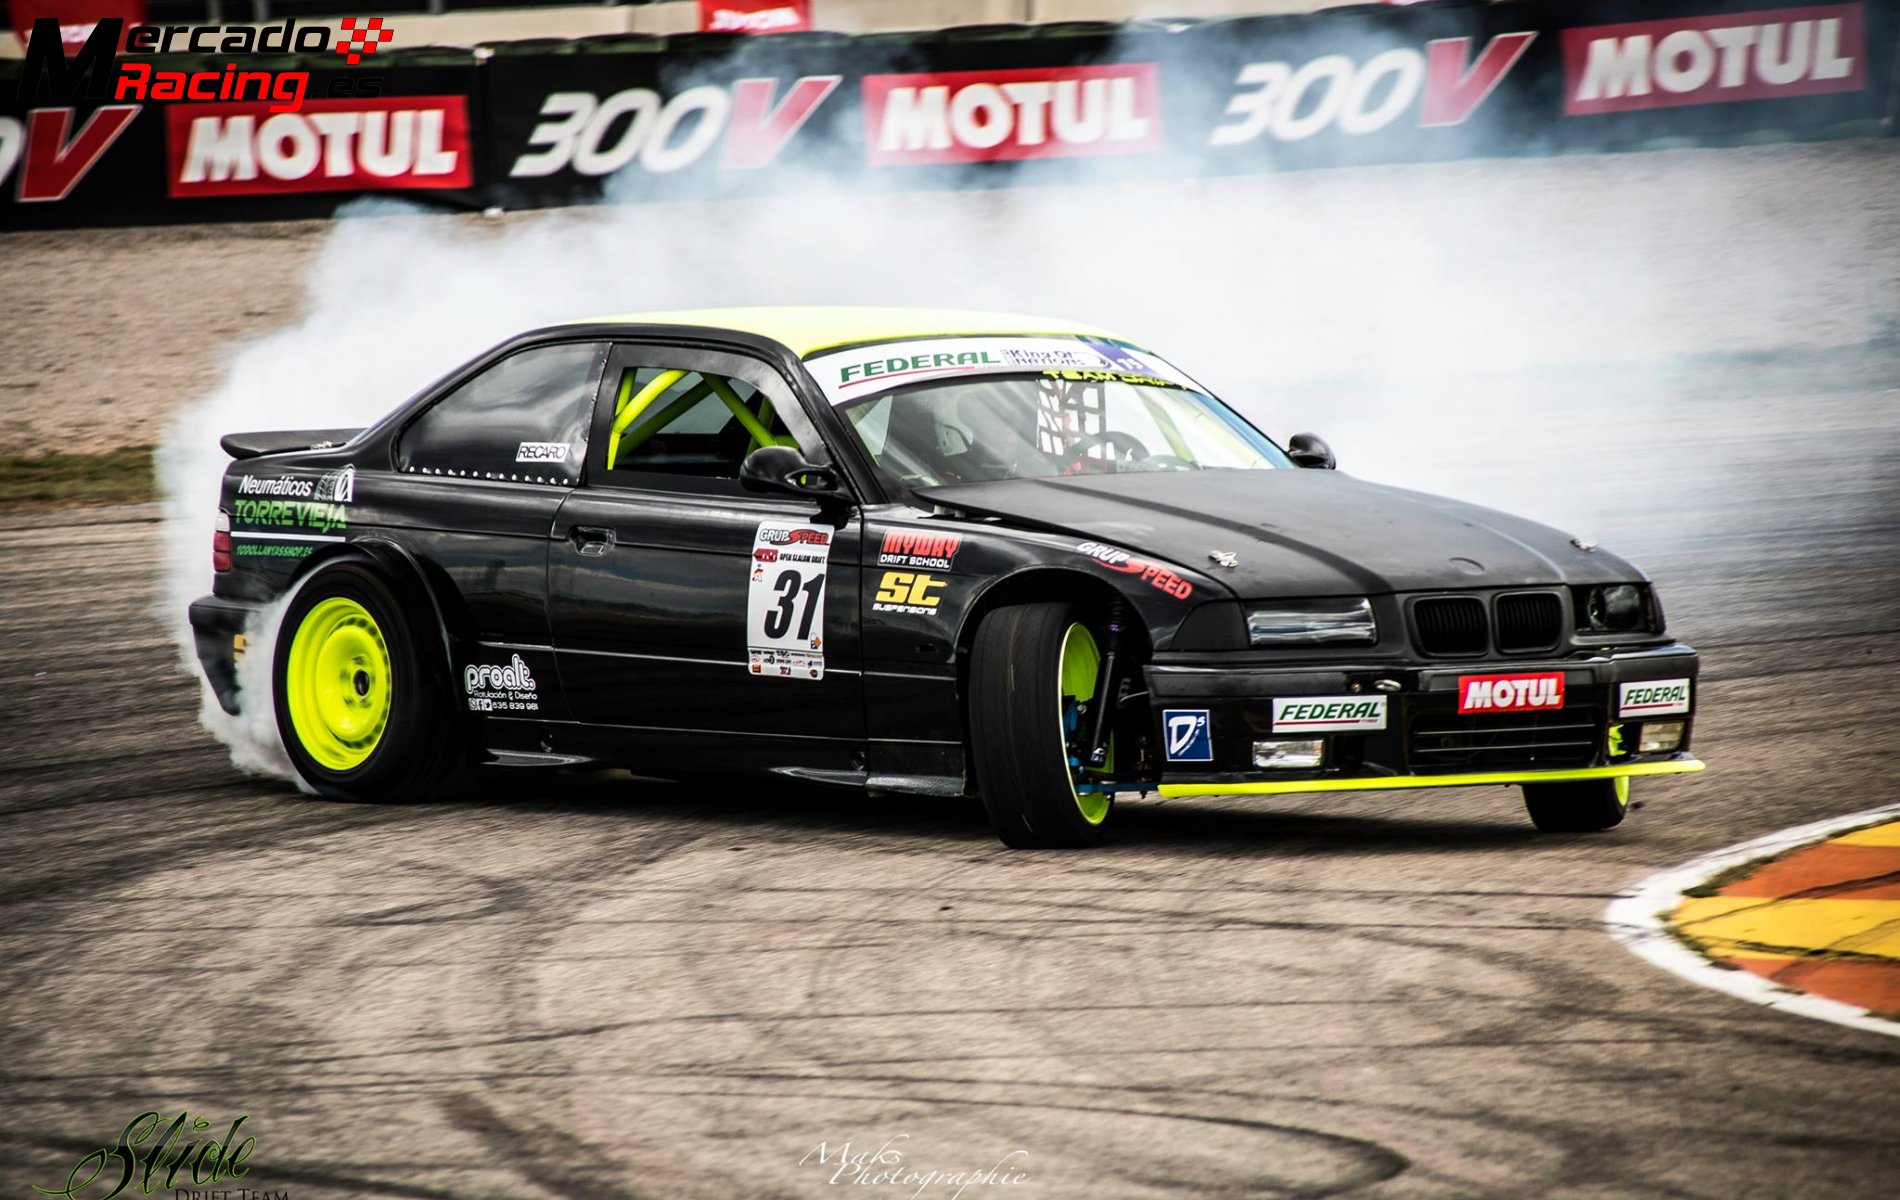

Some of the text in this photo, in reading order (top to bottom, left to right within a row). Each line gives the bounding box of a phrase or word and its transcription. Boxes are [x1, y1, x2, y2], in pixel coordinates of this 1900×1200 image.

[1575, 18, 1855, 102] MOTUL
[1207, 31, 1538, 146] 300V
[509, 75, 842, 177] 300V
[877, 77, 1150, 151] MOTUL
[180, 111, 457, 183] MOTUL
[841, 351, 1001, 383] FEDERAL
[517, 446, 567, 460] RECARO
[238, 475, 313, 497] Neumáticos
[235, 499, 346, 534] TORREVIEJA
[883, 530, 961, 559] MYWAY
[880, 554, 950, 569] DRIFT SCHOOL
[764, 570, 825, 641] 31
[1464, 678, 1560, 709] MOTUL
[1624, 686, 1686, 705] FEDERAL
[1279, 702, 1381, 720] FEDERAL
